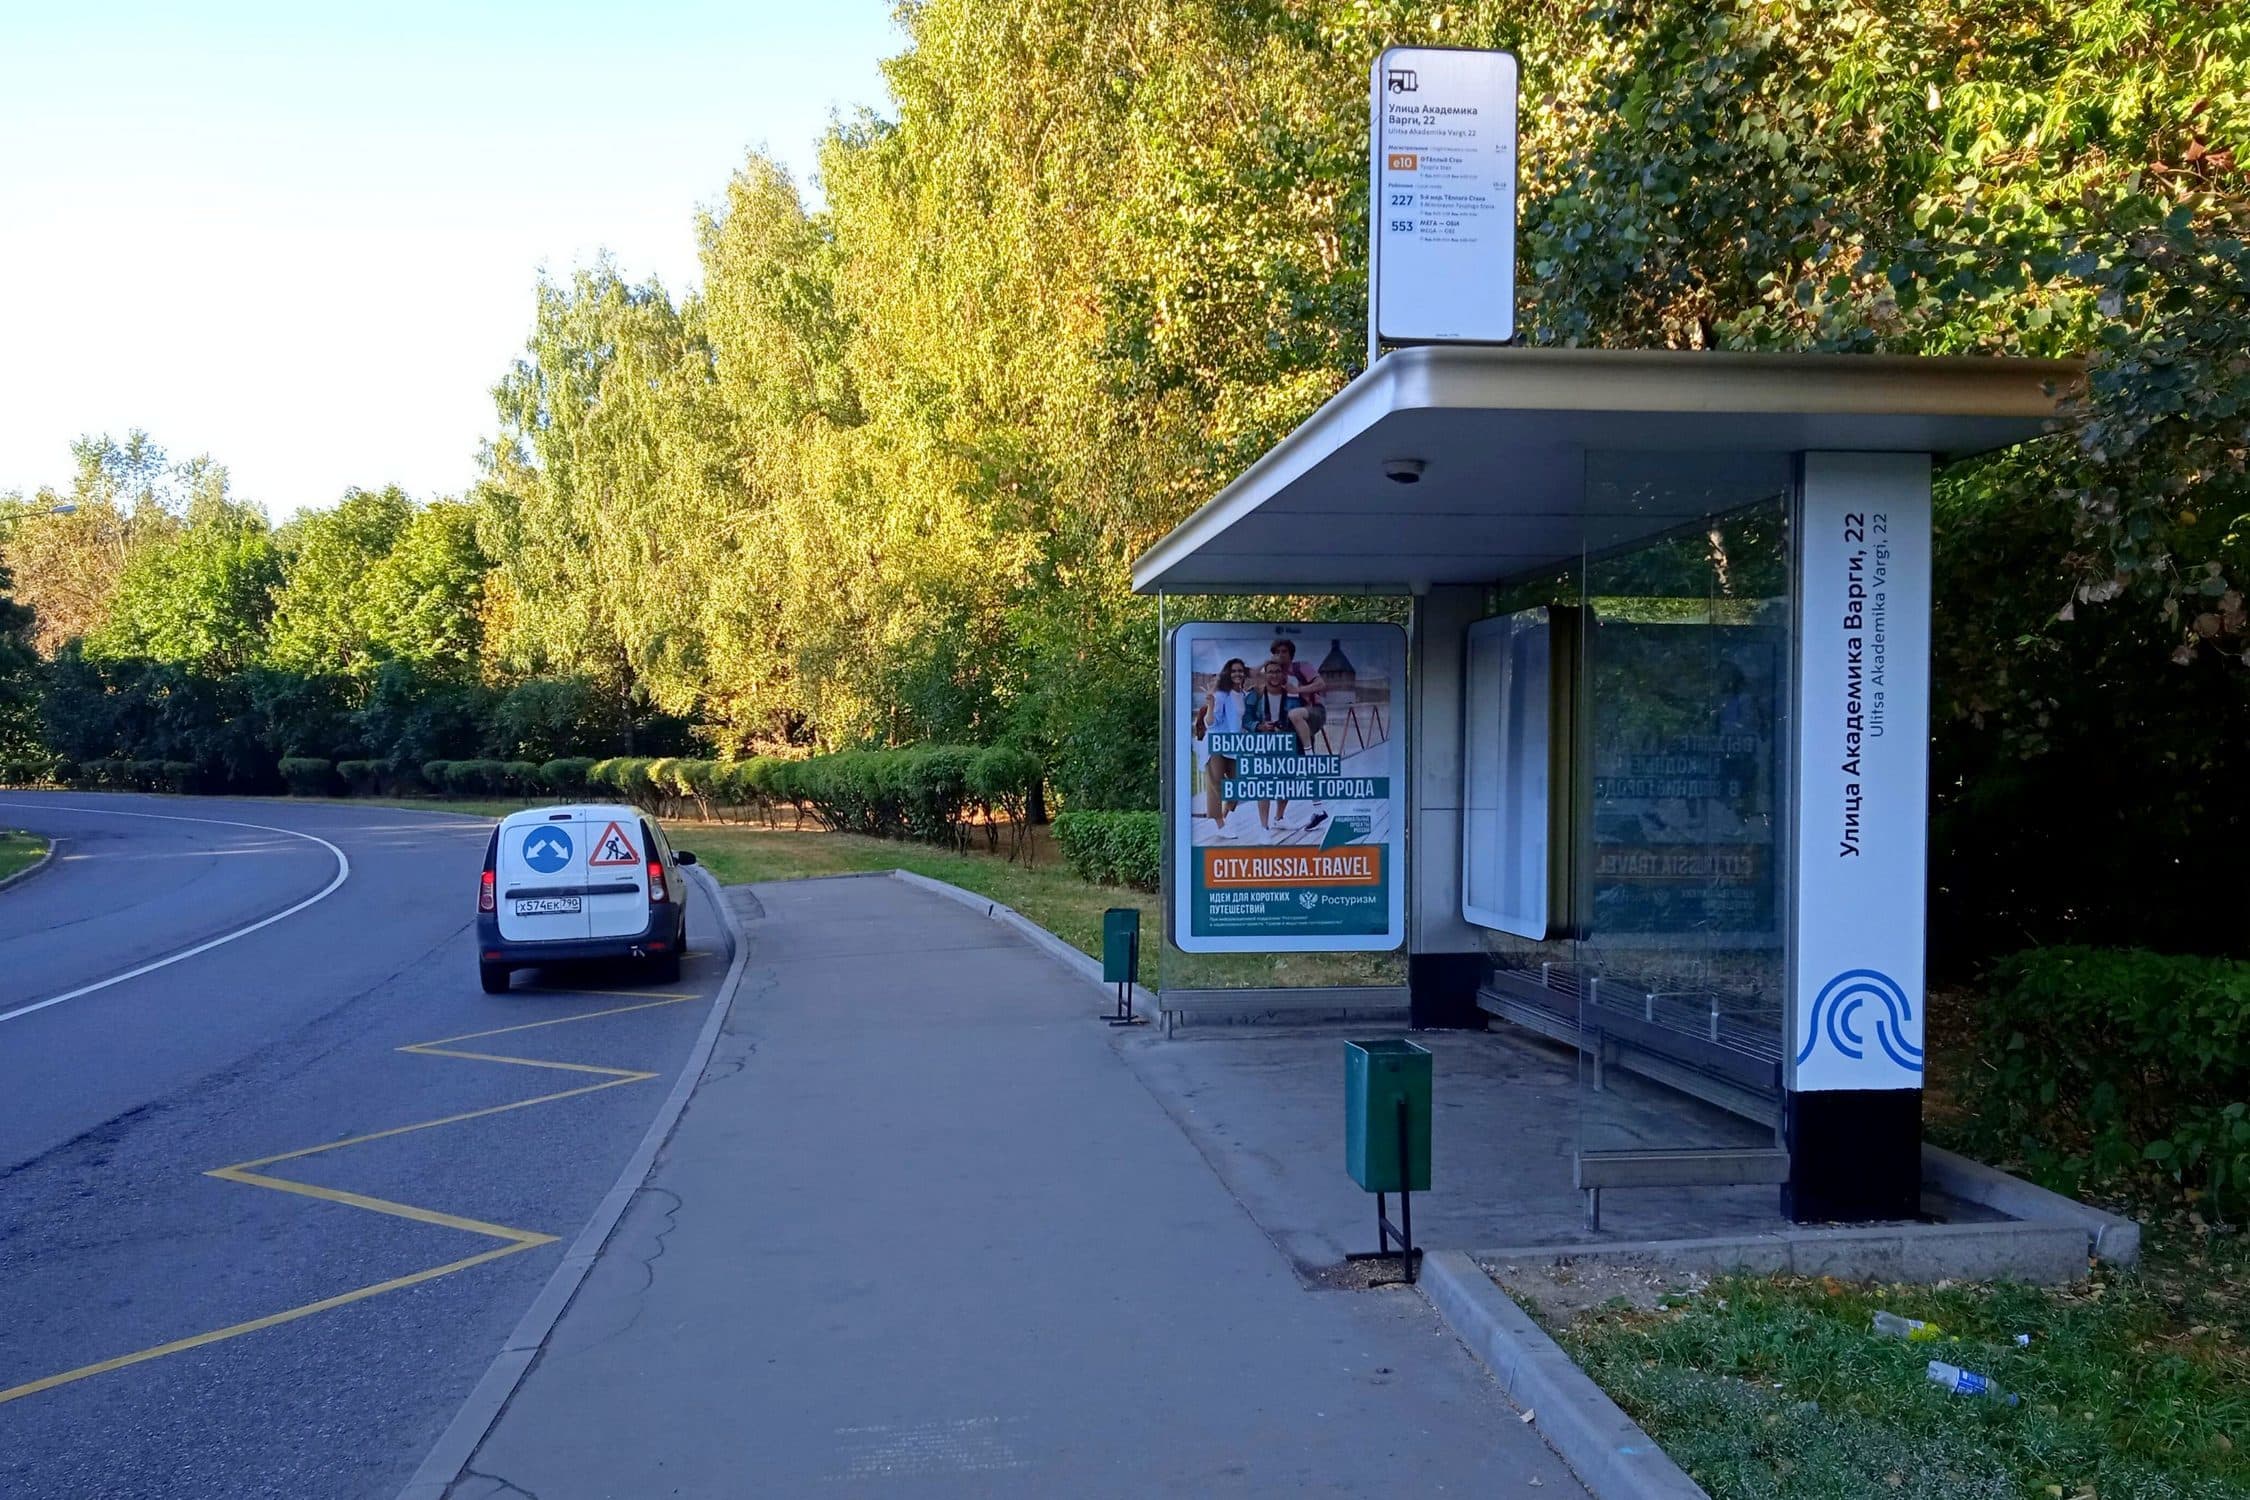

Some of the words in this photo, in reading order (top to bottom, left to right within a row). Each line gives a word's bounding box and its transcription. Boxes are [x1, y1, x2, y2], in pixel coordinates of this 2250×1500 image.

[1388, 104, 1420, 114] Улица
[1422, 105, 1478, 115] Академика
[1388, 115, 1421, 126] Варги,
[1423, 116, 1435, 125] 22
[1392, 157, 1413, 168] e10
[1391, 195, 1414, 206] 227
[1391, 221, 1414, 232] 553
[1844, 512, 1864, 543] 22
[1873, 513, 1887, 534] 22
[1872, 540, 1890, 588] Vargi,
[1843, 550, 1867, 629] Варги,
[1870, 592, 1886, 686] Akademika
[1841, 637, 1864, 777] Академика
[1870, 692, 1884, 737] Ulitsa
[1213, 734, 1294, 752] ВЫХОДИТЕ
[1240, 758, 1249, 775] В
[1253, 757, 1340, 776] ВЫХОДНЫЕ
[1224, 781, 1233, 798] В
[1238, 780, 1314, 799] СОСЕДНИЕ
[1318, 779, 1374, 798] ГОРОДА
[1840, 784, 1863, 857] Улица
[1213, 856, 1372, 878] CITY.RUSSIA.TRAVEL
[1209, 892, 1231, 903] ИДЕИ
[1232, 892, 1250, 903] ДЛЯ
[1250, 892, 1290, 902] КОРОТКИХ
[1321, 895, 1377, 906] Ростуризм
[1209, 903, 1265, 915] ПУТЕШЕСТВИЙ
